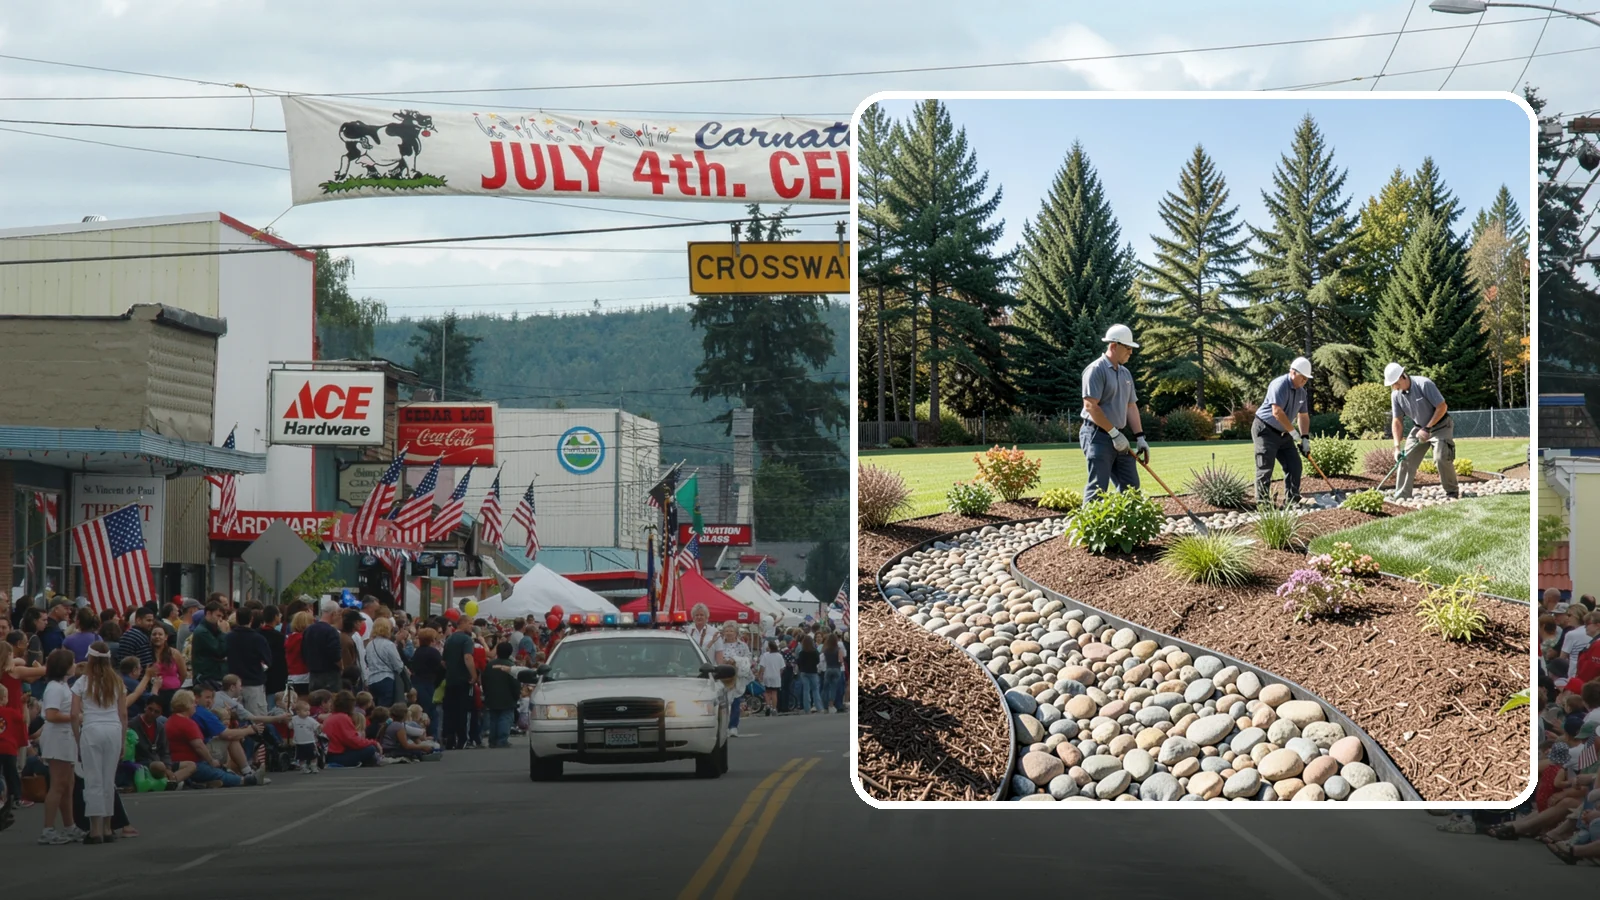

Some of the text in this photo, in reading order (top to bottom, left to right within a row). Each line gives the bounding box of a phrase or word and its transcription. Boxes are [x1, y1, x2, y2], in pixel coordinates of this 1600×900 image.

[481, 140, 605, 193] JULY
[632, 149, 747, 198] 4th.
[696, 254, 850, 280] CROSSWA
[282, 379, 374, 420] ACE
[405, 409, 452, 421] CEDAR
[283, 420, 371, 437] Hardware
[416, 427, 477, 447] Coca-Cola
[353, 467, 386, 480] Simpl
[95, 484, 124, 495] Vincent
[126, 485, 135, 495] de
[137, 486, 155, 495] Paul
[688, 526, 742, 535] CRNATION
[699, 535, 730, 543] GLASS
